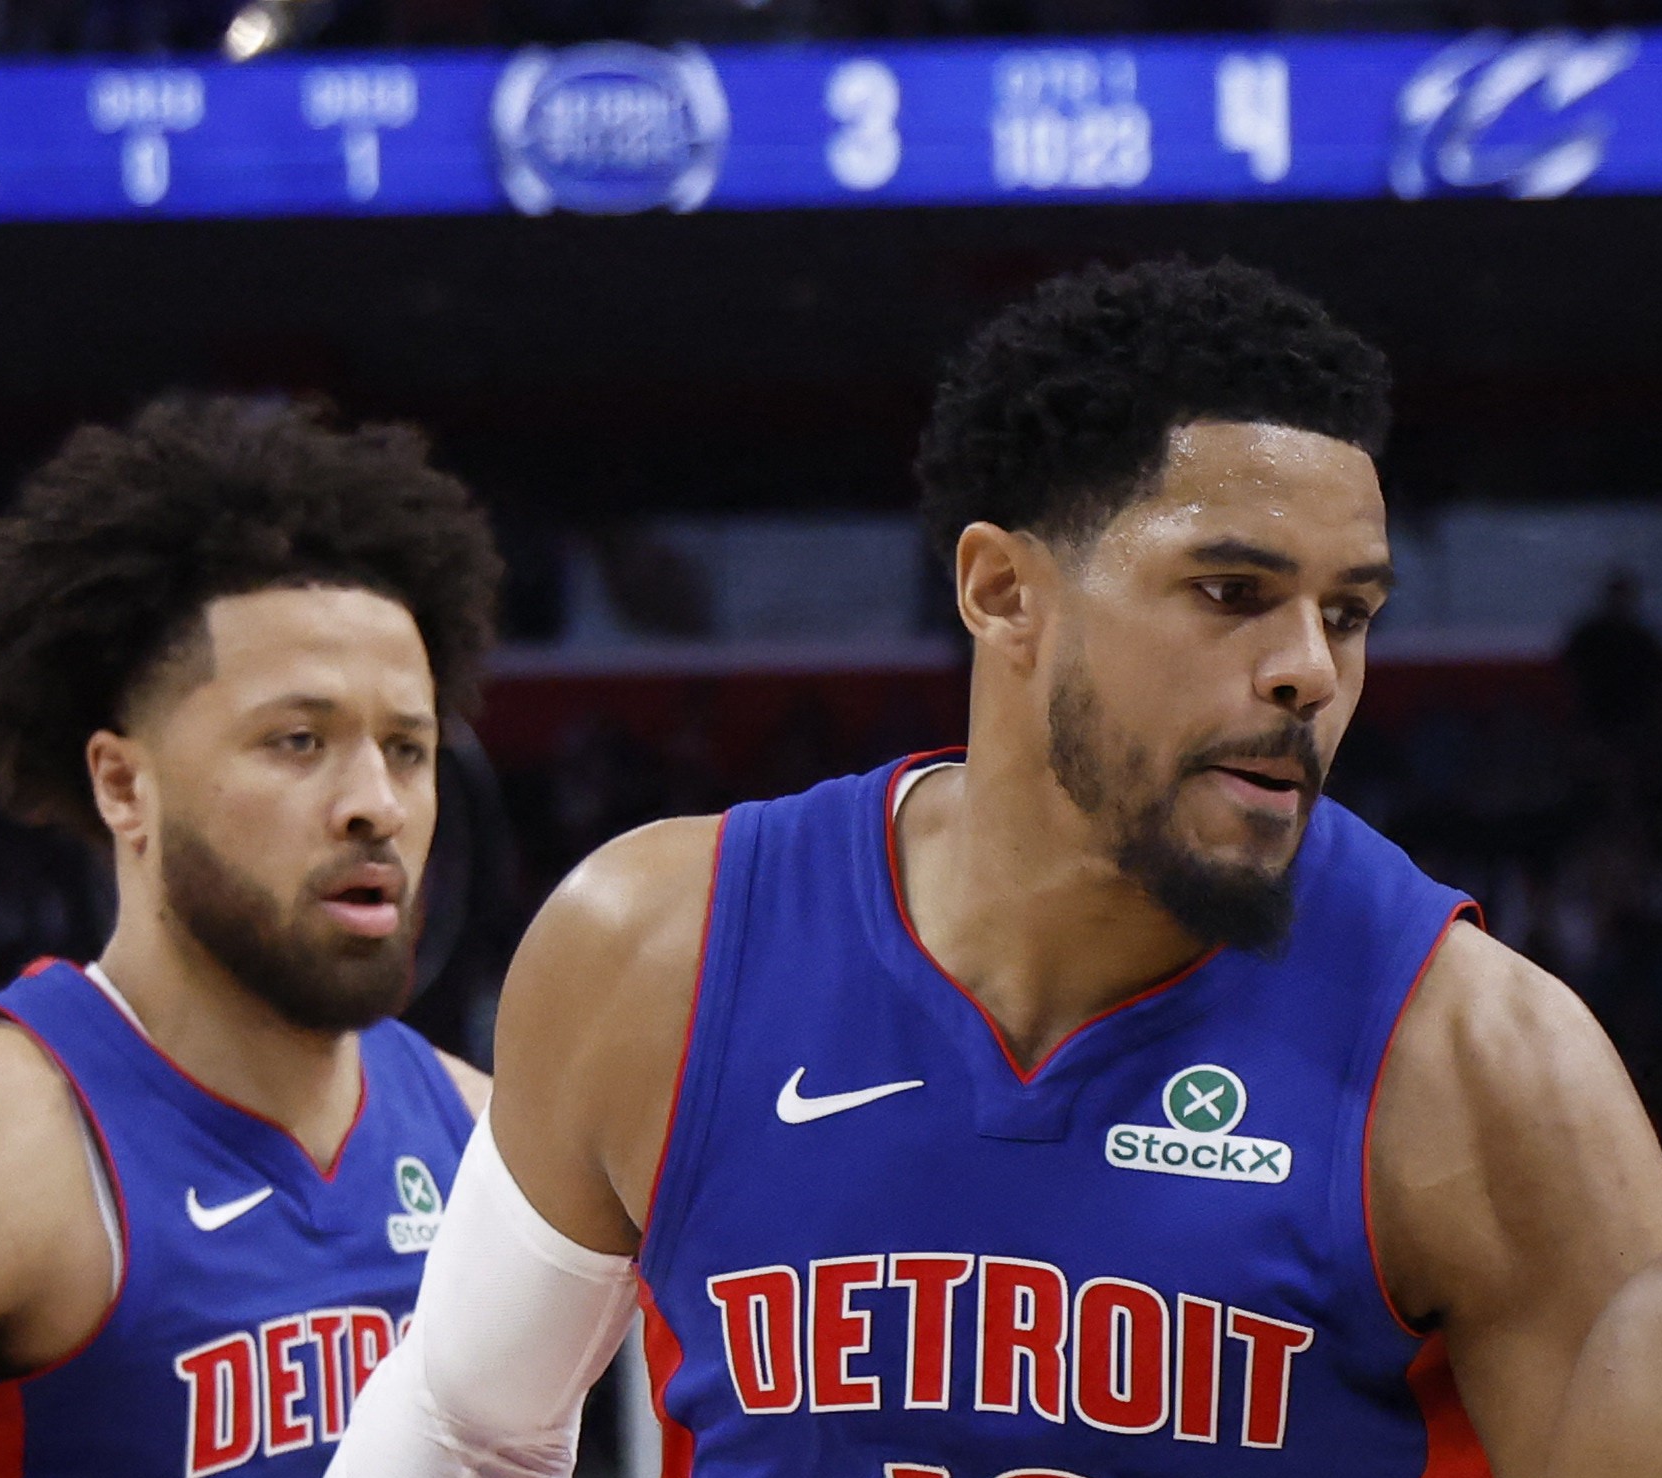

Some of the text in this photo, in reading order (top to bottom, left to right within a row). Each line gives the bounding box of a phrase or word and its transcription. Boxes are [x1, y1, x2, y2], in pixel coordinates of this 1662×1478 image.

[826, 58, 901, 191] 3
[1216, 52, 1291, 184] 4
[1111, 1130, 1282, 1176] StockX
[392, 1221, 440, 1245] Sto
[707, 1252, 1314, 1449] DETROIT
